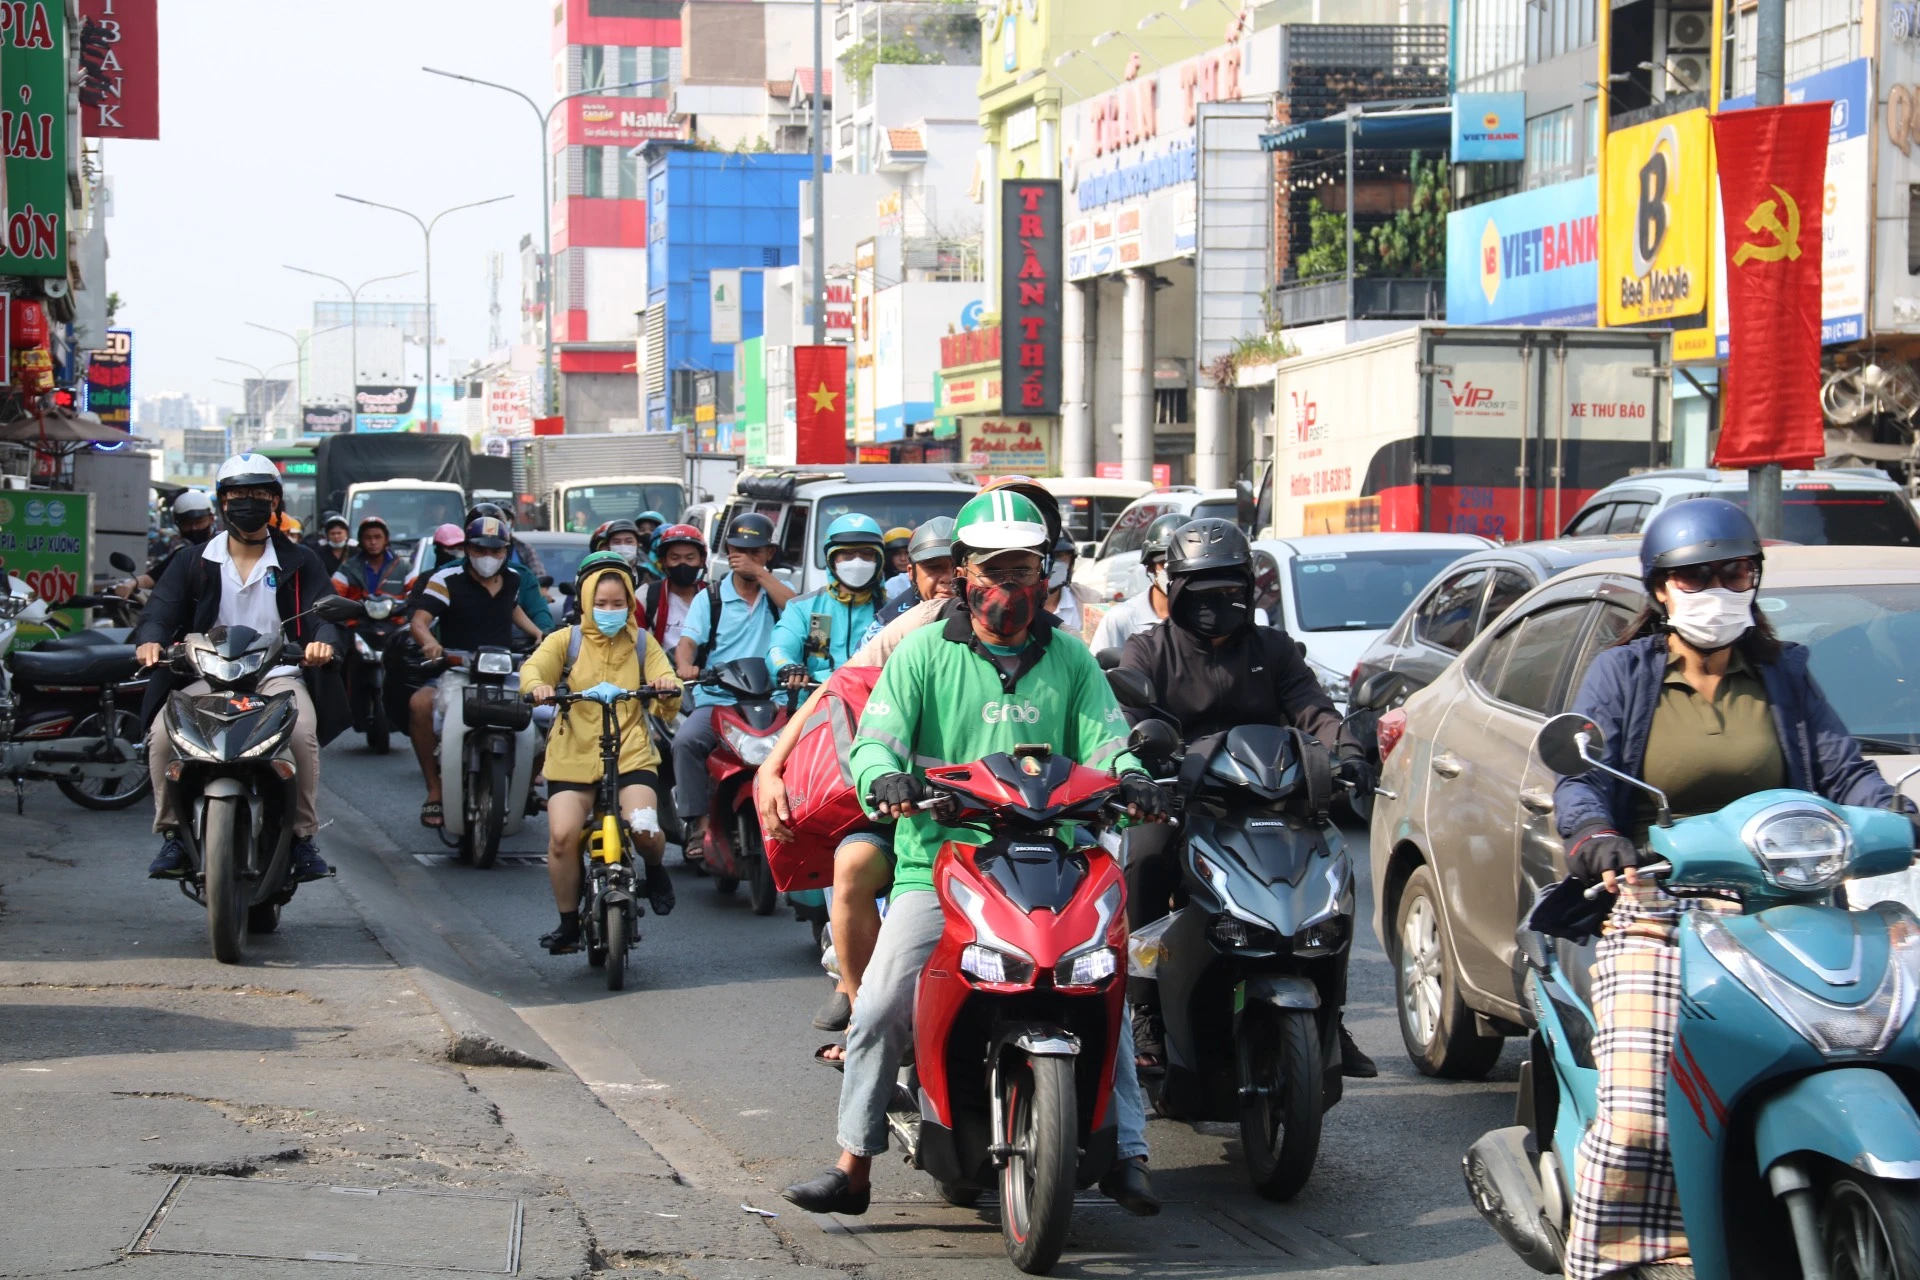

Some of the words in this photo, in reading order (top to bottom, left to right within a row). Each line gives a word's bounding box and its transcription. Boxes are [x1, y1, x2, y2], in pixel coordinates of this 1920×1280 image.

[1463, 132, 1519, 141] VIETBANK
[1501, 213, 1598, 280] VIETBANK
[1621, 276, 1643, 309] Bee
[1649, 266, 1690, 304] Mobile
[1571, 403, 1587, 417] XE
[1592, 402, 1617, 418] THƯ
[1620, 400, 1645, 418] BÁO
[1459, 488, 1493, 509] 29H
[982, 699, 1040, 724] Grab
